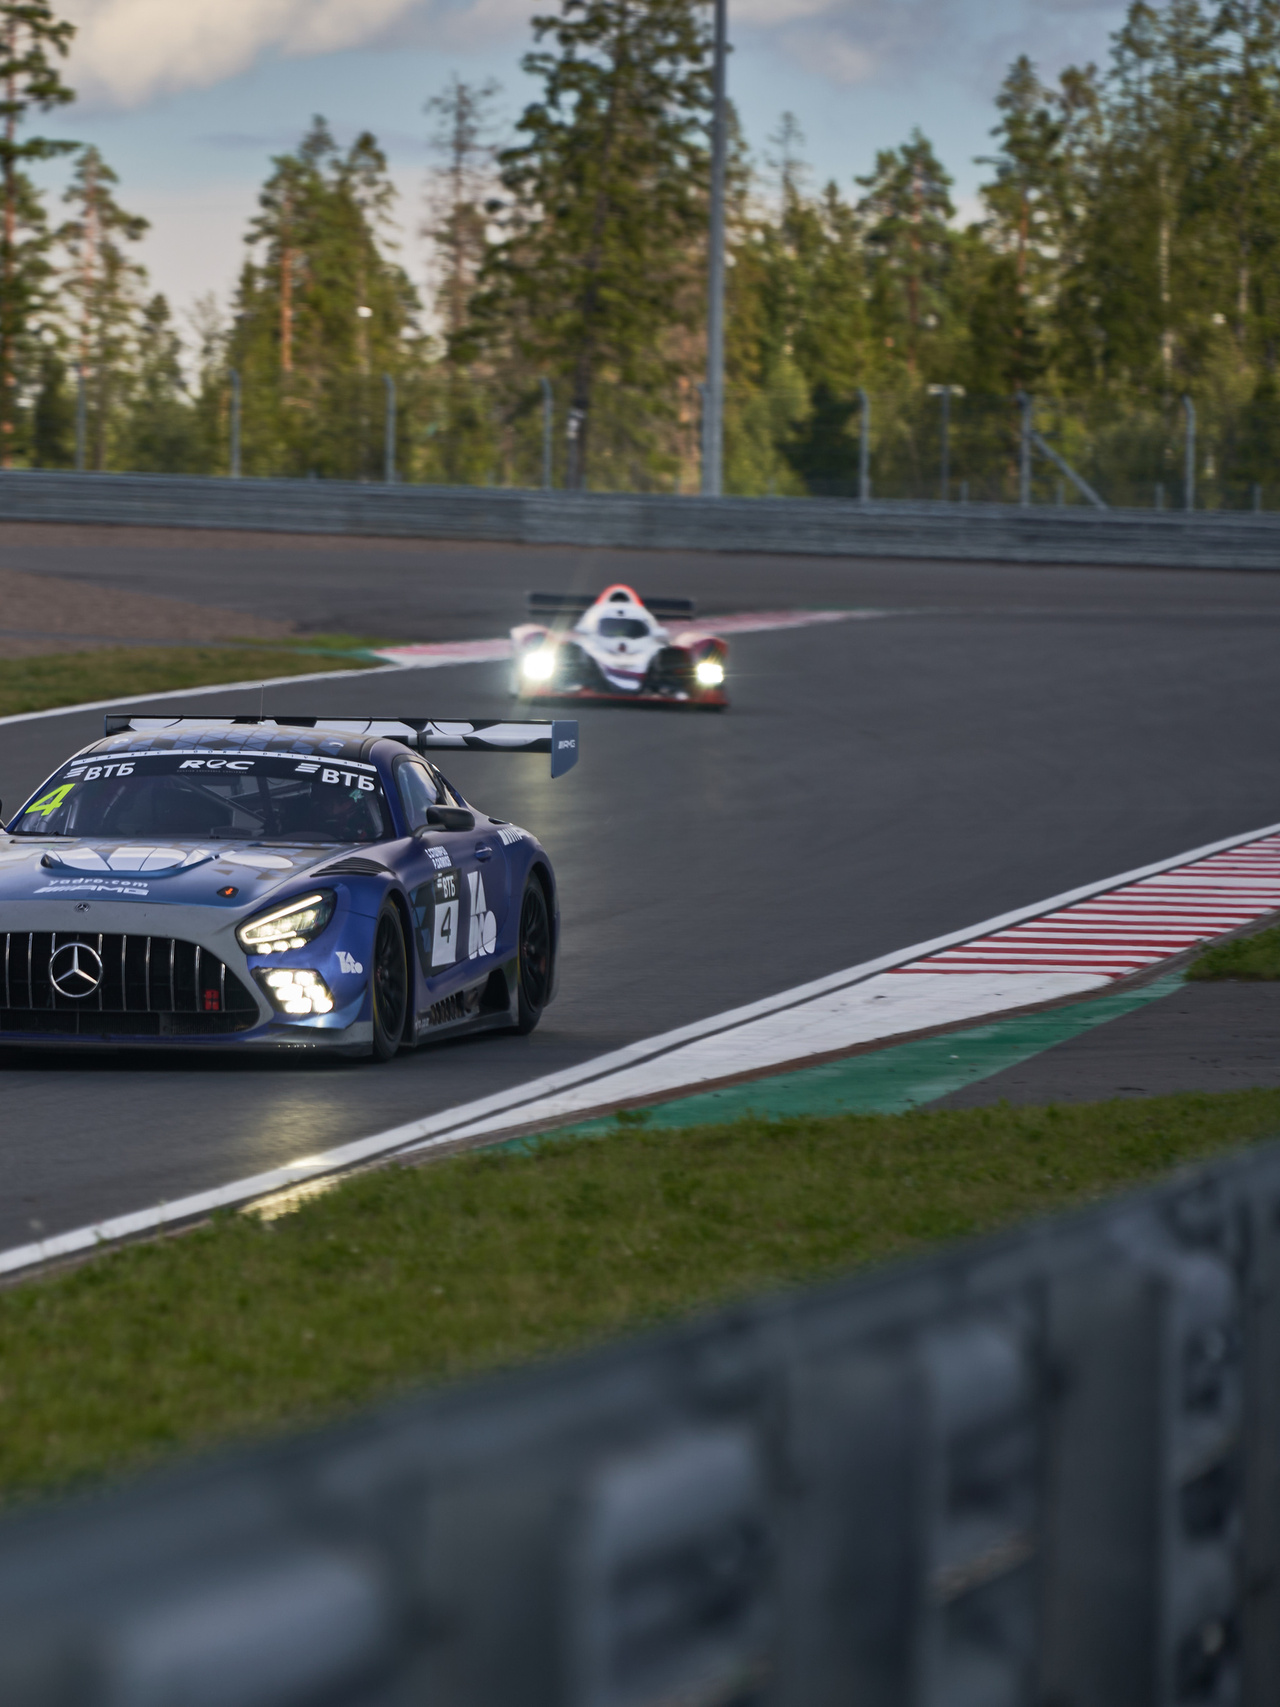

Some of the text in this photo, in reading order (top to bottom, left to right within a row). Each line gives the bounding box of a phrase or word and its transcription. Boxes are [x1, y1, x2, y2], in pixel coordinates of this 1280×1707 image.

[321, 768, 376, 792] ВТБ
[24, 783, 76, 816] 4
[48, 877, 149, 888] yadro.com
[440, 906, 452, 944] 4
